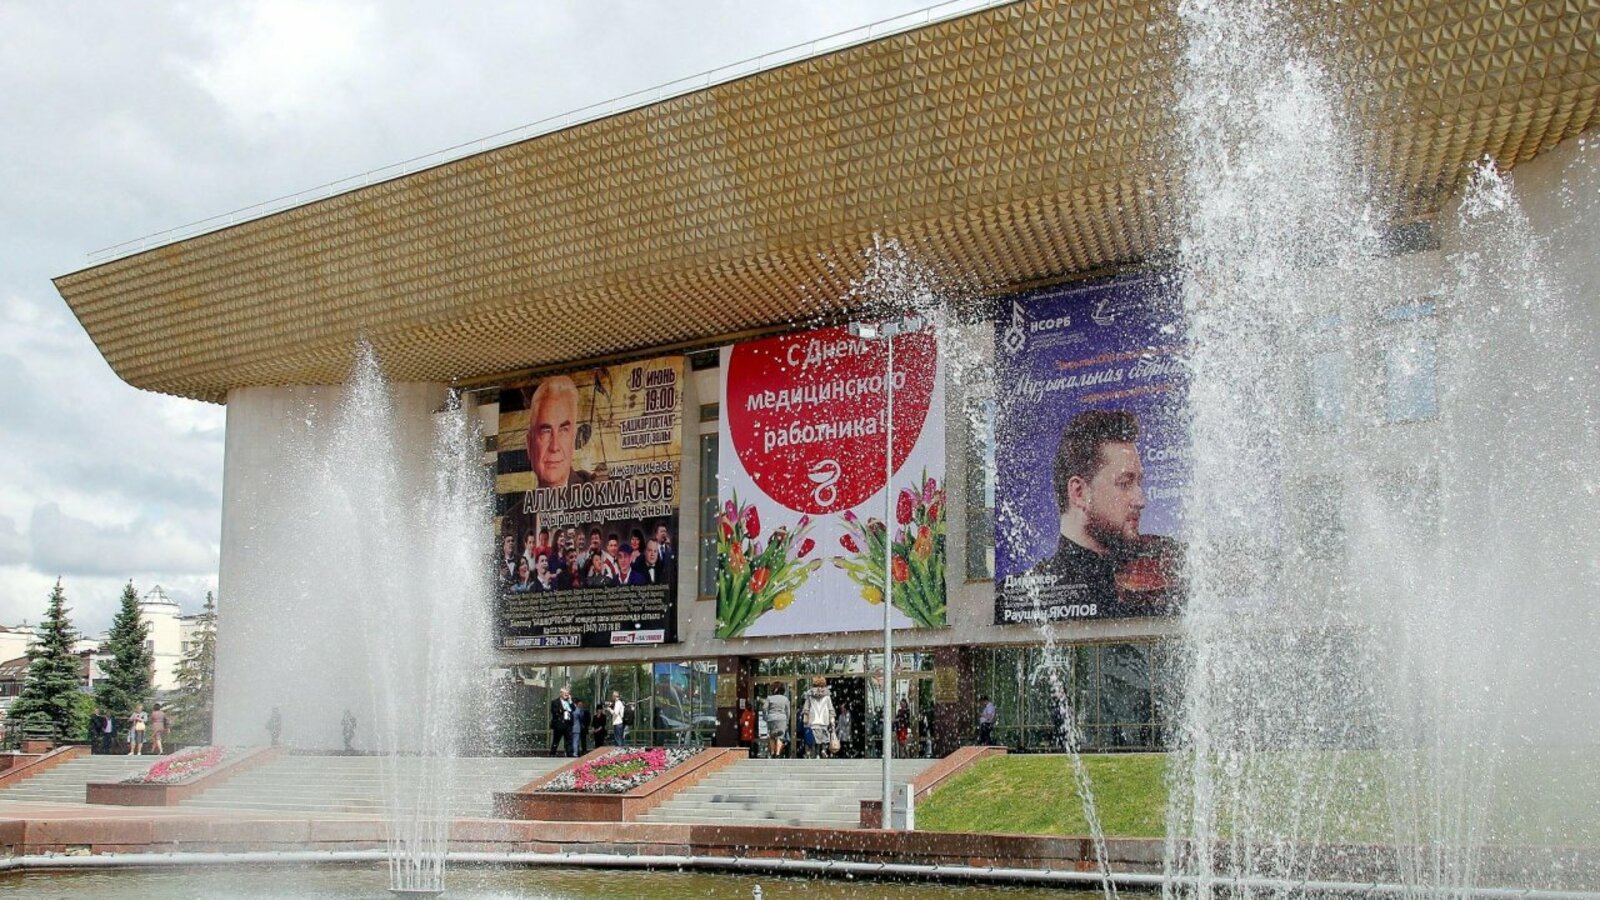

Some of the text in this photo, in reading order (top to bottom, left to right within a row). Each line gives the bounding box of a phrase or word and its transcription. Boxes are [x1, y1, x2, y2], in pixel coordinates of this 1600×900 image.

[787, 343, 801, 366] С
[630, 366, 676, 390] 18 ИЮНЬ
[1008, 369, 1124, 404] Музыкальная
[645, 387, 676, 412] 19:00
[764, 410, 886, 454] работника!
[523, 476, 674, 514] АЛИК ЛОКМАНОВ
[1049, 603, 1098, 619] ЯКУПОВ
